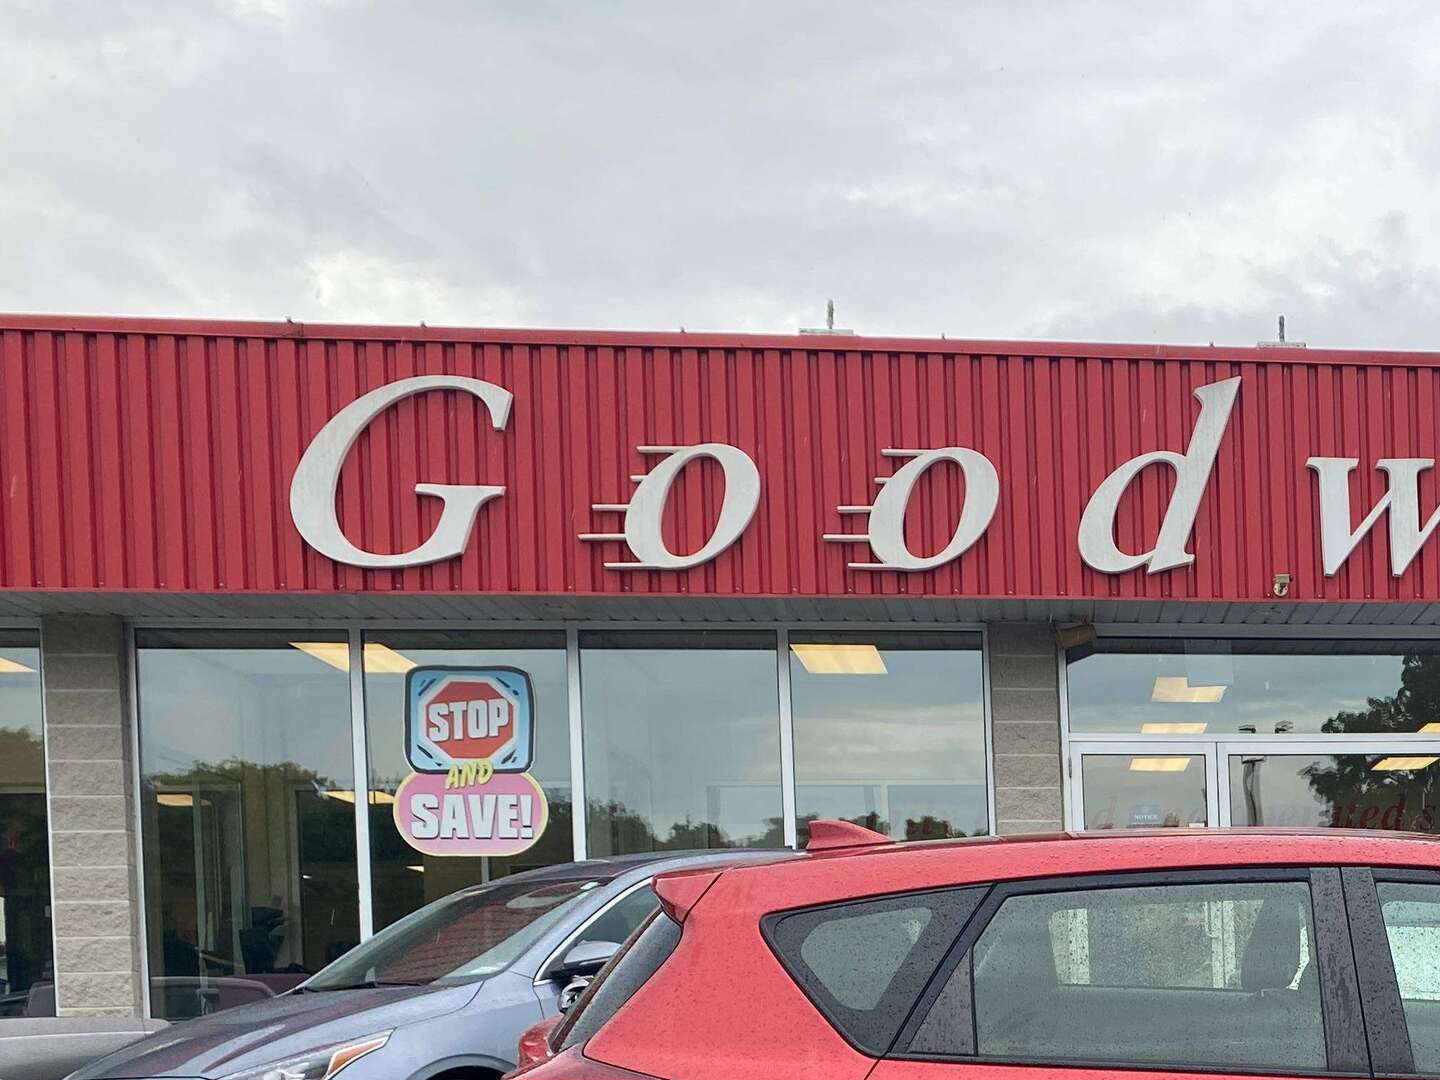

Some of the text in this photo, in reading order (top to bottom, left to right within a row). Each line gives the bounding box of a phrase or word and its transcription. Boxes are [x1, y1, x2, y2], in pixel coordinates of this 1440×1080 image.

[428, 698, 510, 743] STOP
[445, 760, 494, 790] AND
[410, 793, 534, 840] SAVE!
